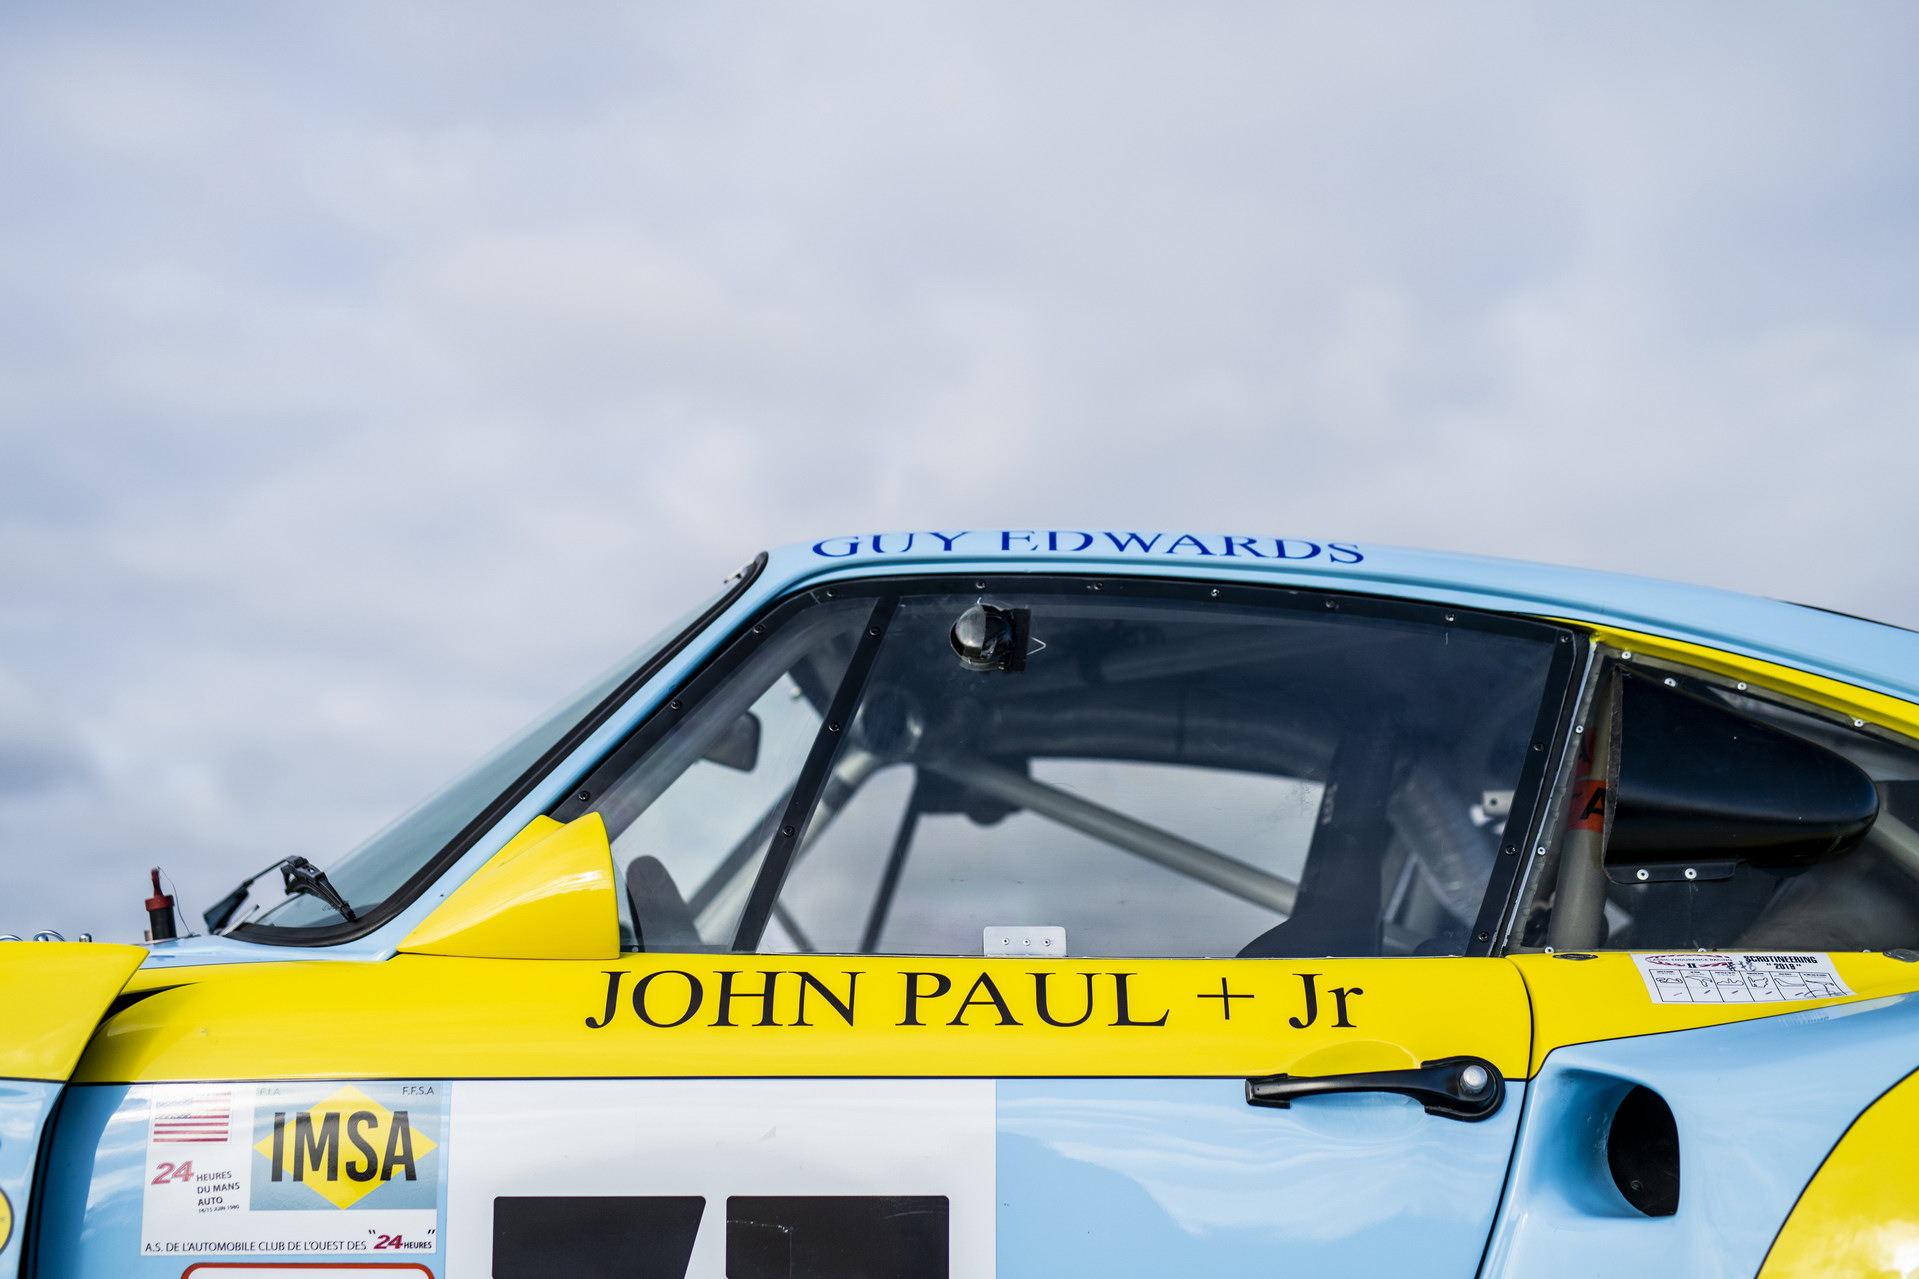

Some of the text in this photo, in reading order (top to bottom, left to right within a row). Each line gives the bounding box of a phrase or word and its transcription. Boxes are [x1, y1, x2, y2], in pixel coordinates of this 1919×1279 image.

[812, 530, 1365, 564] GUY EDWARDS
[1743, 955, 1818, 964] SCRUTINEERING
[584, 970, 1365, 1029] JOHN PAUL + Jr
[271, 1110, 417, 1183] IMSA
[152, 1160, 232, 1186] 24 HEURES
[197, 1182, 240, 1194] DU MANS
[197, 1195, 223, 1207] AUTO
[145, 1241, 163, 1252] A.S.
[166, 1241, 180, 1252] DE
[182, 1241, 256, 1252] L'AUTOMOBILE
[258, 1241, 285, 1251] CLUB
[287, 1241, 301, 1251] DE
[304, 1240, 345, 1251] L'OUEST
[347, 1240, 367, 1251] DES
